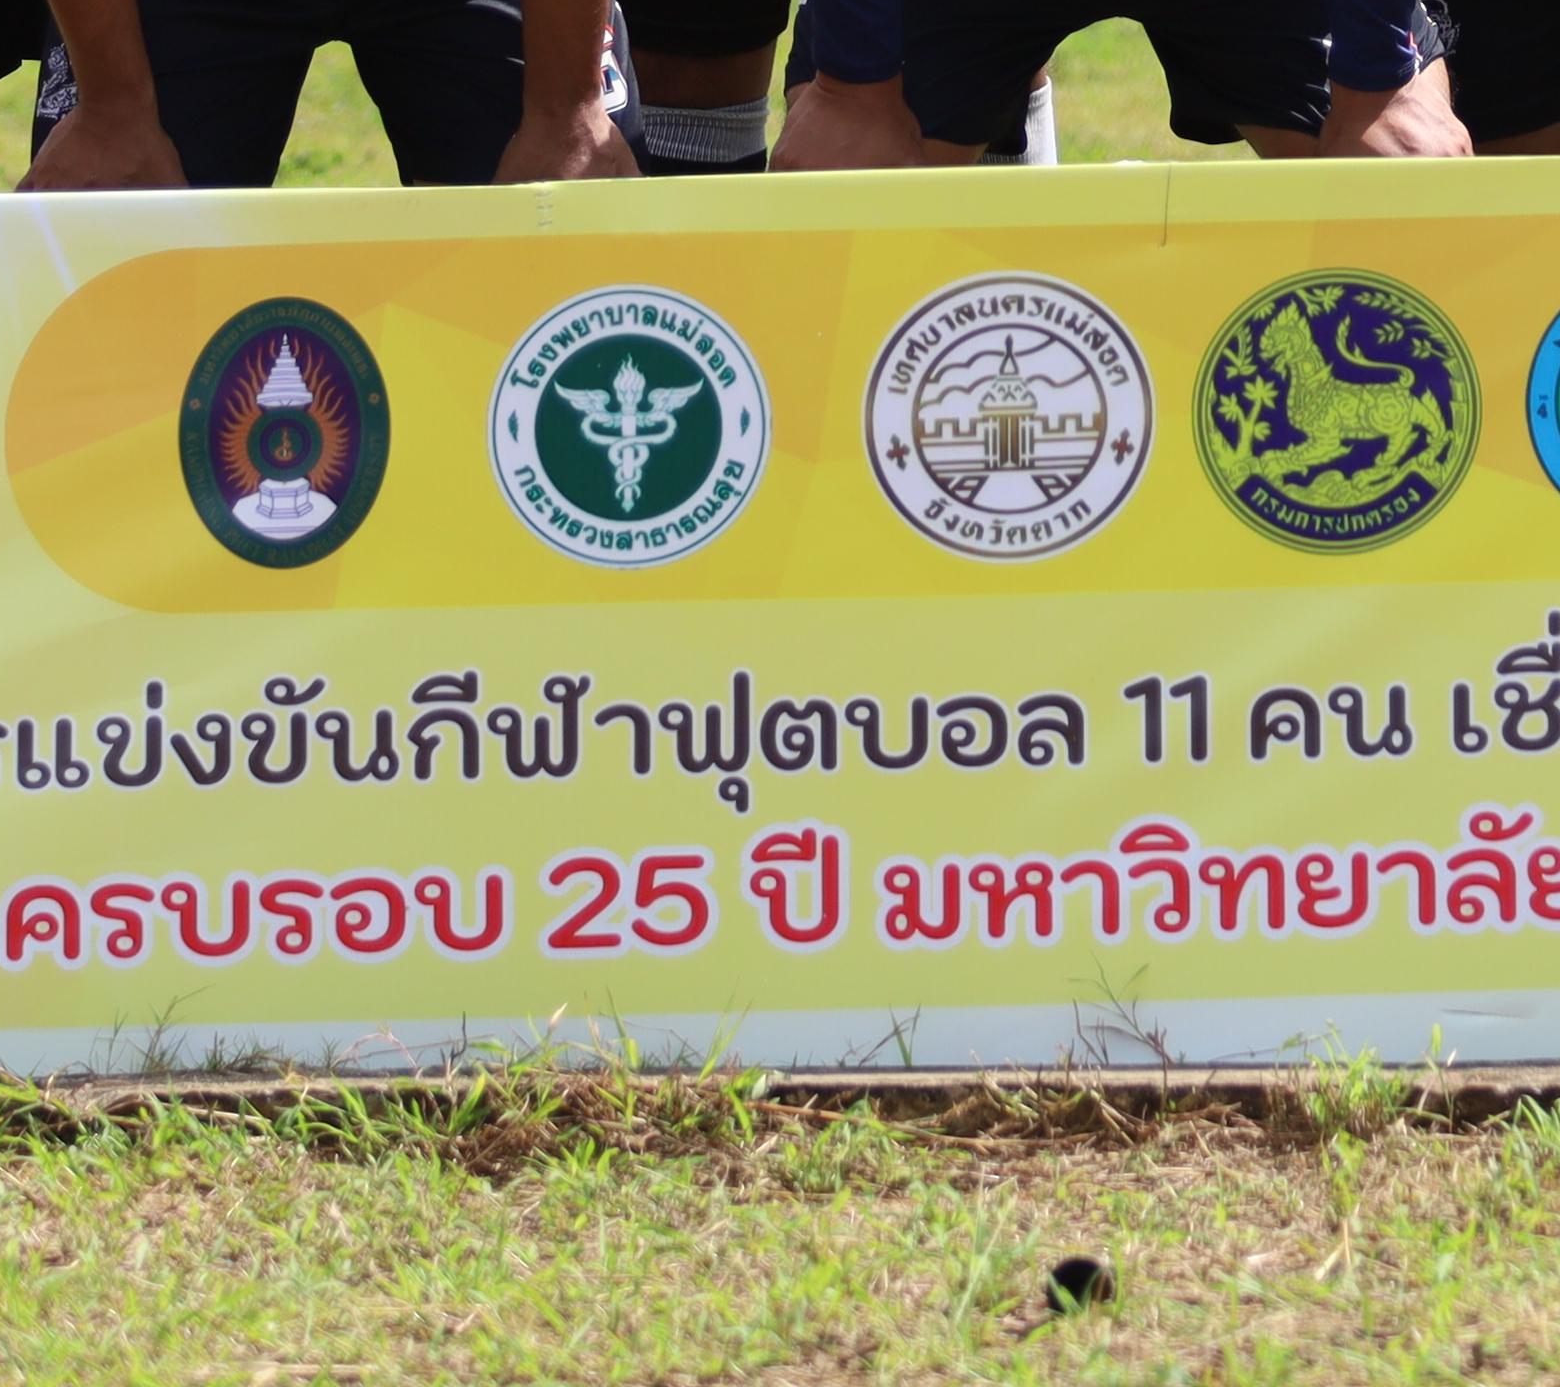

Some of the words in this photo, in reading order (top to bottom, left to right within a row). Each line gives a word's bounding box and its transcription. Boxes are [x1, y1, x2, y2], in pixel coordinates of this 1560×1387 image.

[511, 301, 737, 393] โรงพยาบาลแม่สอด
[887, 293, 1131, 396] เทศบาลนครแม่สอด
[514, 458, 747, 553] กระทรวงสาธารณสุข
[1251, 486, 1422, 535] กรมการปกครอง
[1122, 674, 1208, 764] 11
[1248, 682, 1415, 761] คน
[3, 874, 505, 964] ครบรอบ
[545, 854, 712, 950] 25
[748, 827, 840, 944] ปี
